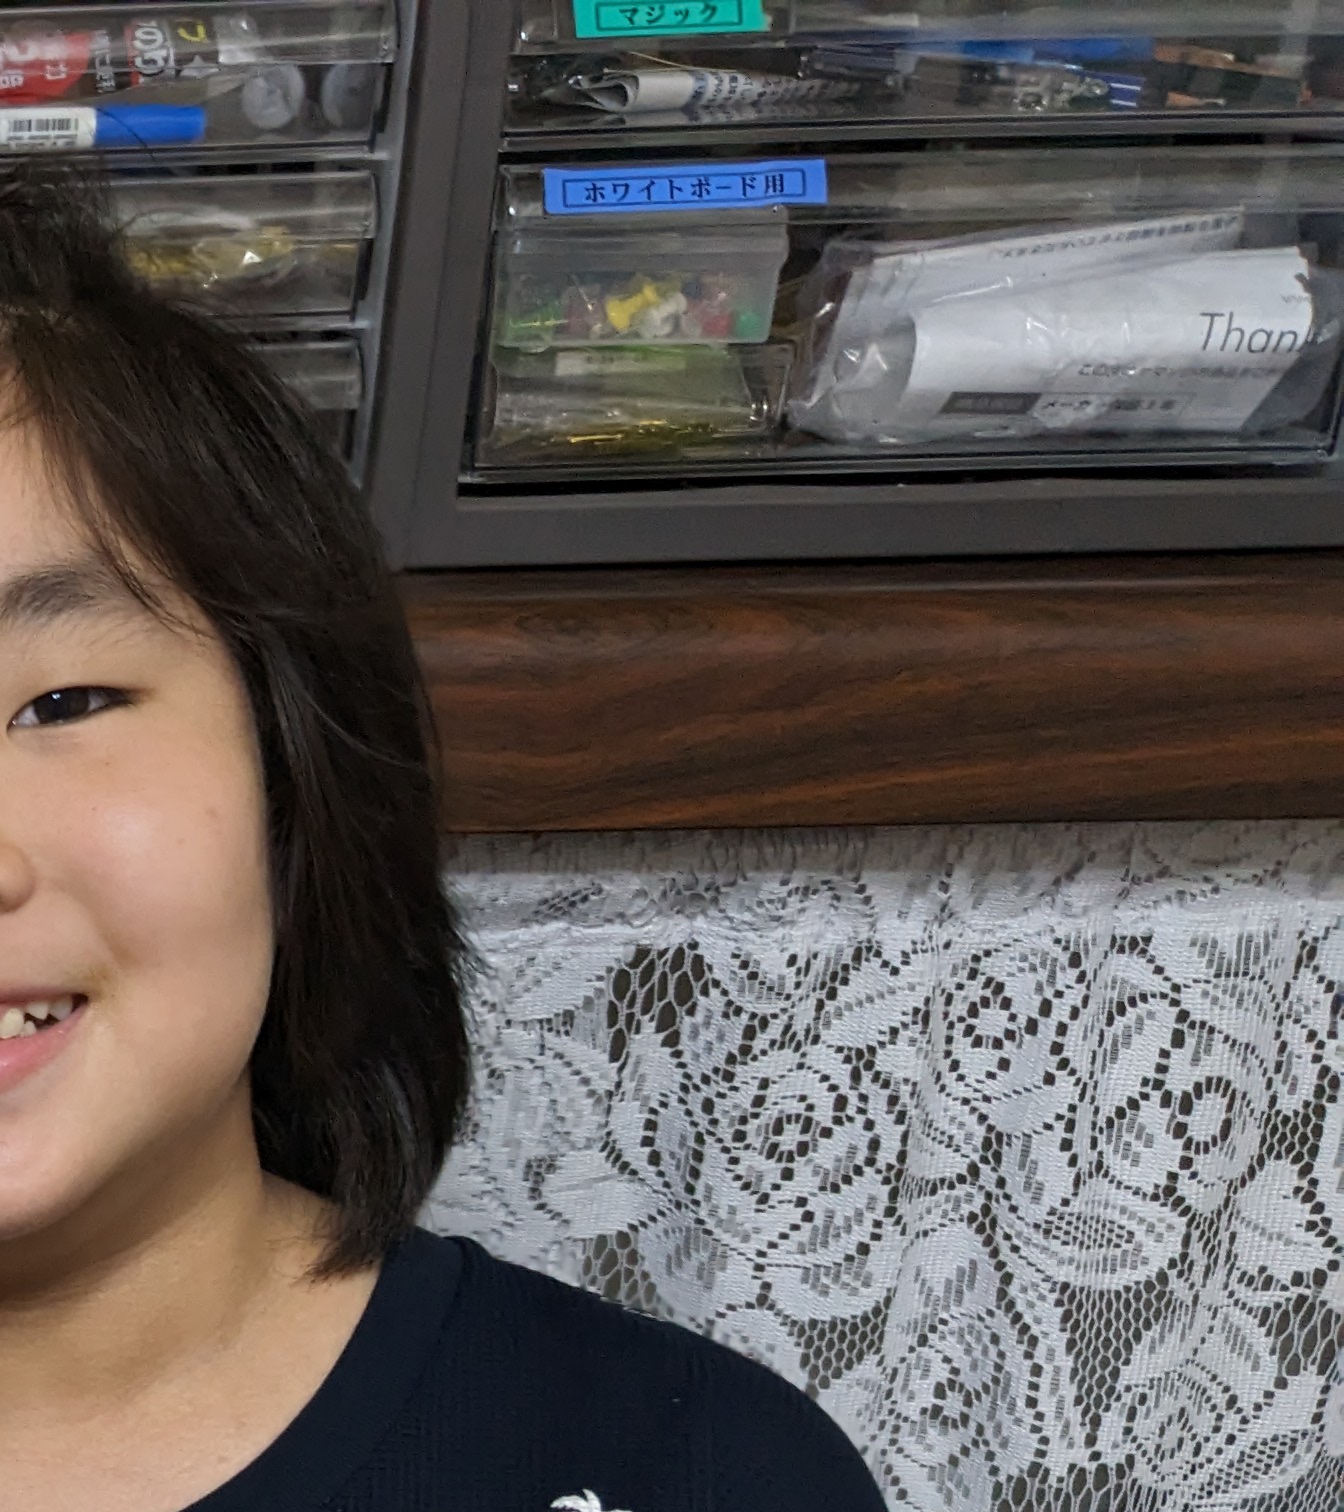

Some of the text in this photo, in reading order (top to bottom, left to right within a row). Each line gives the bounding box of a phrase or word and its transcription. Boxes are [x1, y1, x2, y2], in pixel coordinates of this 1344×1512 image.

[619, 4, 719, 25] マジック
[584, 172, 785, 202] ホワイトボード用
